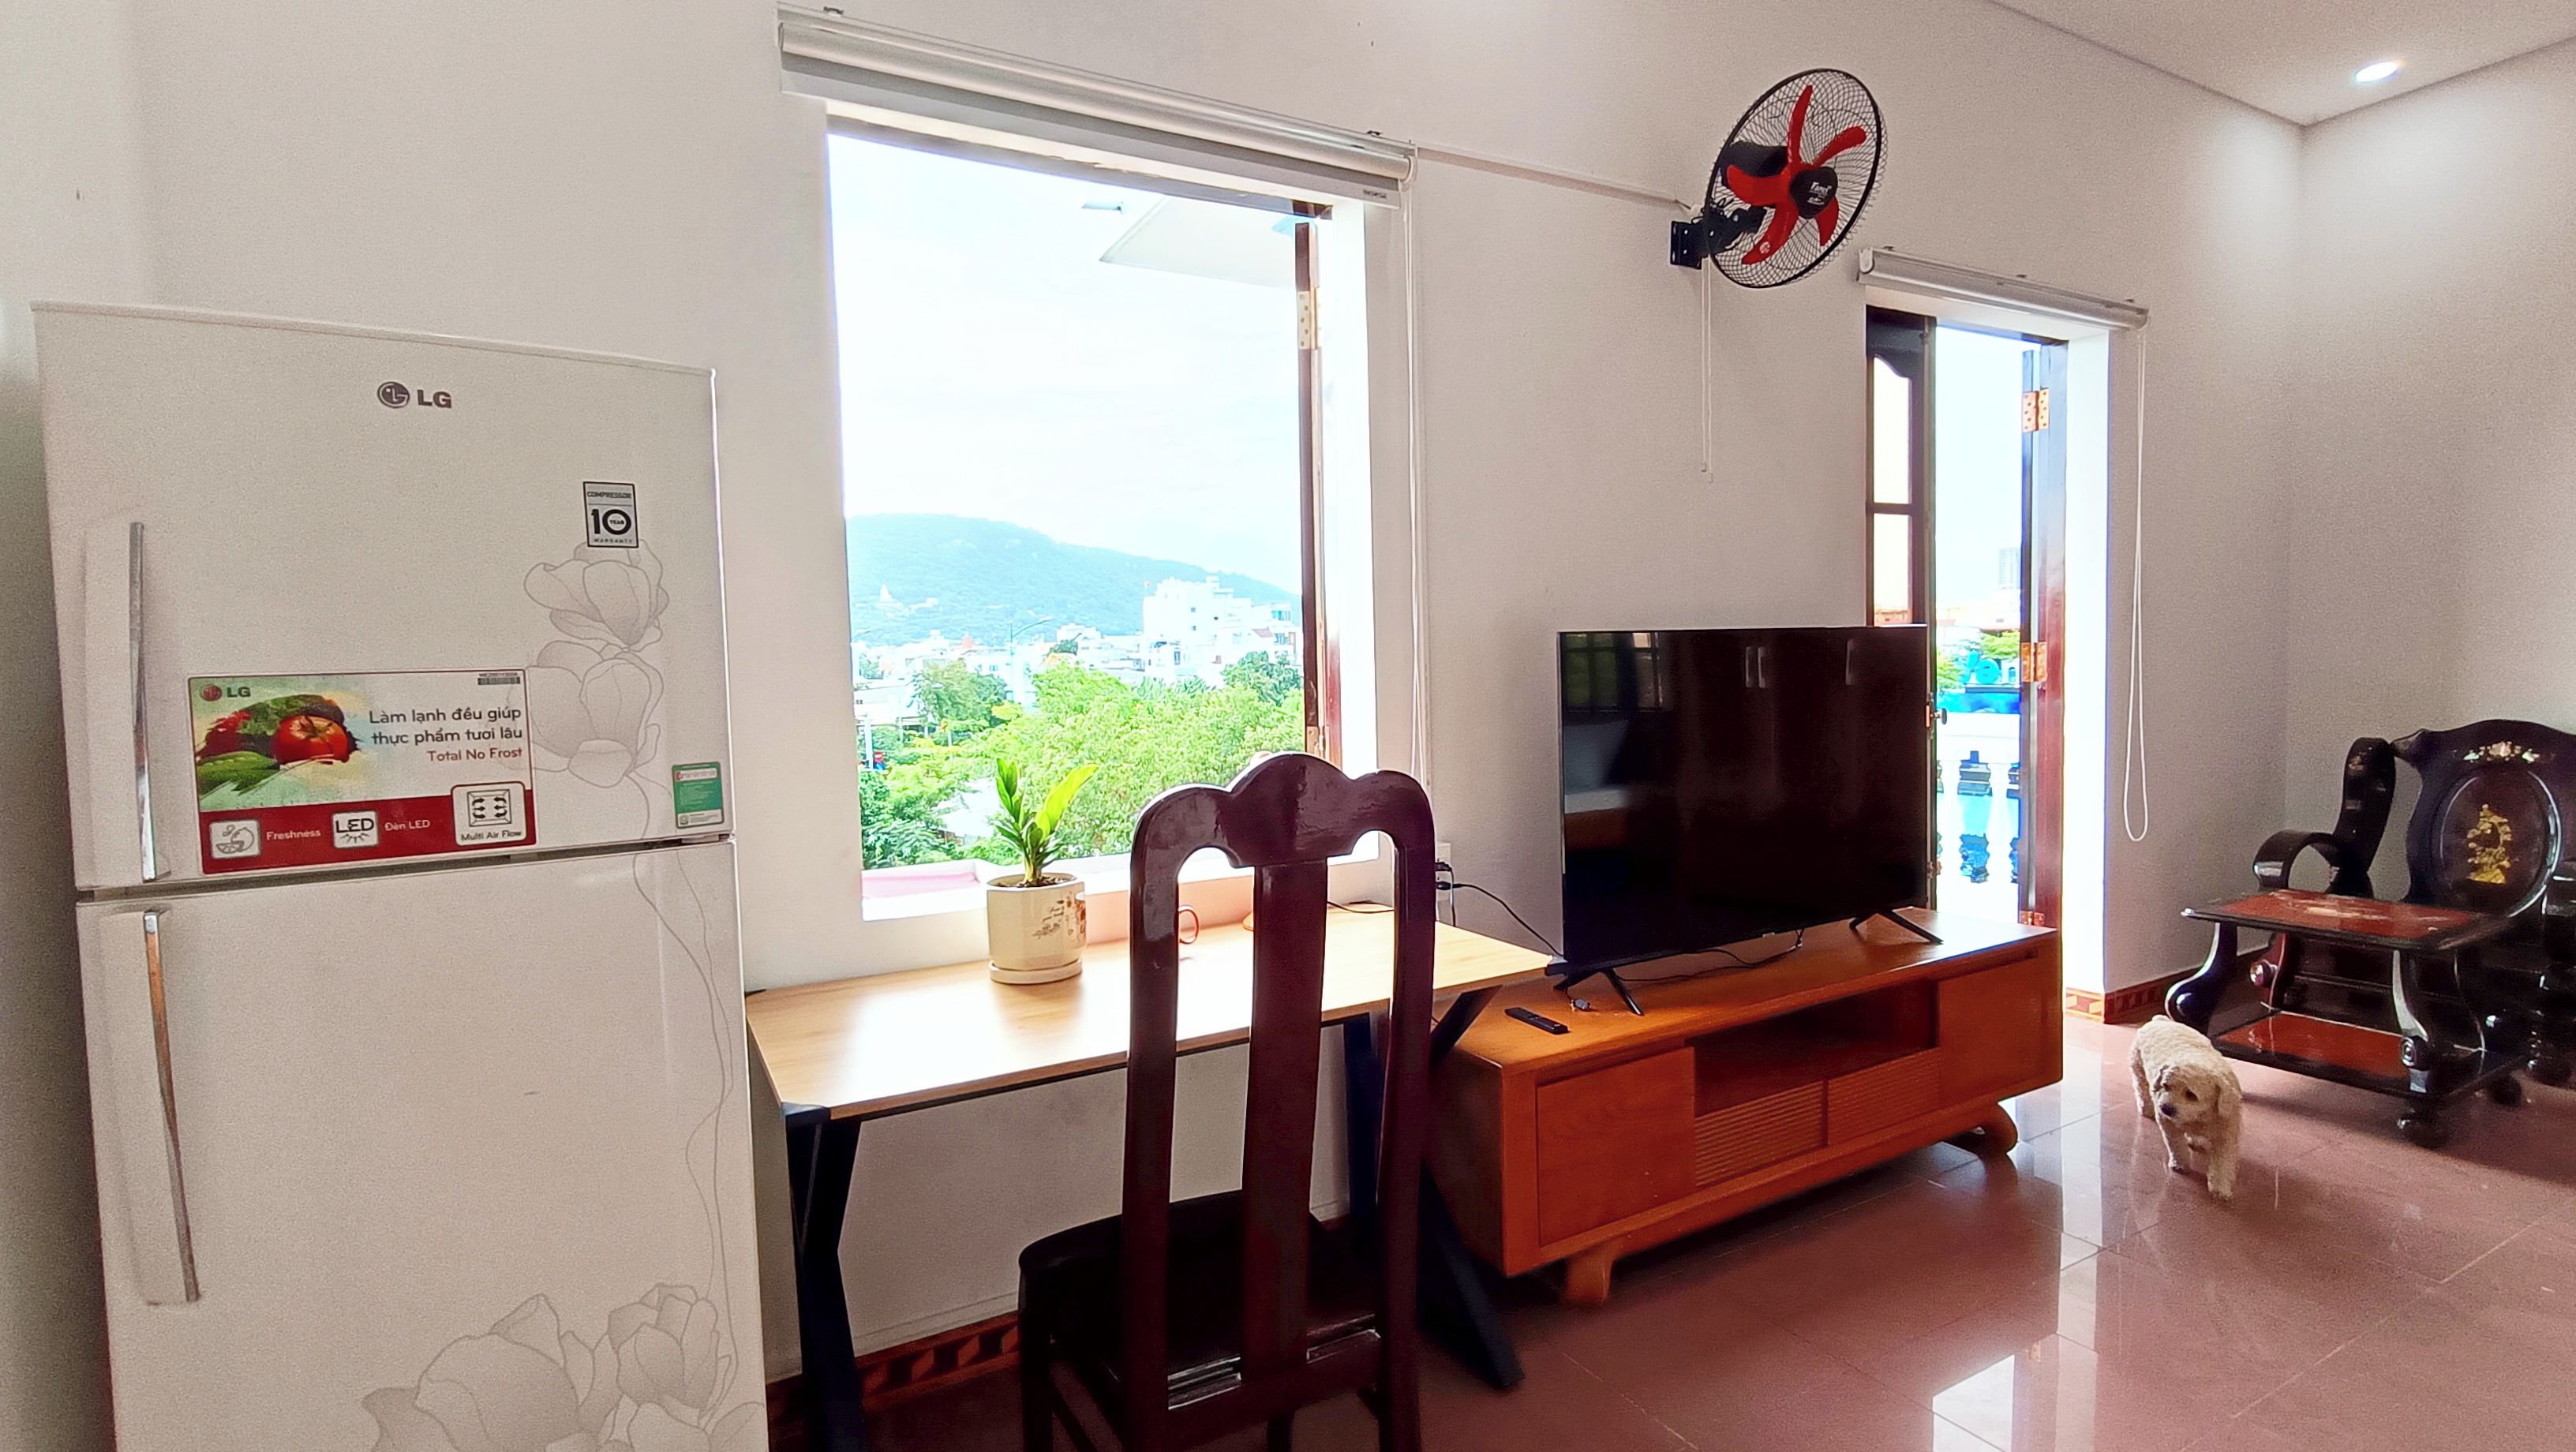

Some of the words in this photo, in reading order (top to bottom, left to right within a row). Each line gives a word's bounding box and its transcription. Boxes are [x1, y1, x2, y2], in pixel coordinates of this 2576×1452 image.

[417, 389, 452, 409] LG
[591, 509, 631, 535] 10
[227, 686, 251, 698] LG
[369, 711, 406, 724] Làm
[412, 709, 447, 724] lạnh
[487, 706, 521, 722] giúp
[372, 731, 409, 746] thực
[414, 728, 460, 746] phẩm
[500, 726, 522, 739] lâu
[427, 750, 462, 762] Total
[466, 749, 485, 760] No
[489, 747, 522, 758] Frost
[335, 818, 375, 833] LED
[384, 822, 406, 831] Đèn
[408, 819, 431, 829] LED
[266, 830, 321, 840] Freshness
[461, 833, 484, 841] Multi
[485, 830, 499, 839] Air
